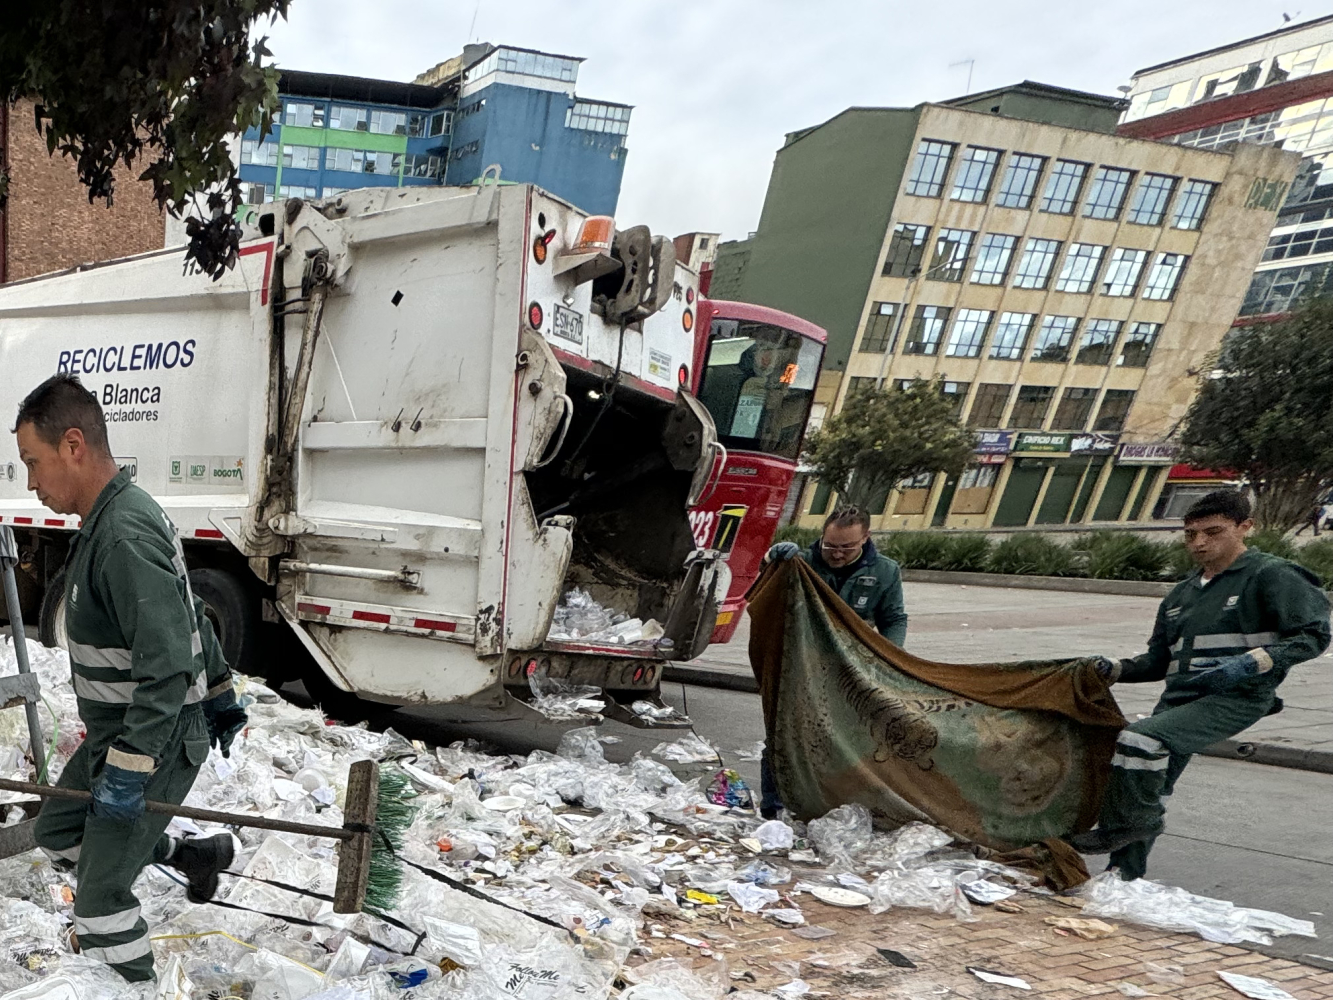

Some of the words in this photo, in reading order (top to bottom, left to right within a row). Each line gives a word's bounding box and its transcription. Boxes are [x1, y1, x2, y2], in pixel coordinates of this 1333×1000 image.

[1244, 177, 1287, 211] REX
[554, 305, 583, 337] ESN-670
[57, 339, 197, 374] RECICLEMOS
[102, 383, 162, 405] Blanca
[103, 408, 159, 423] cicladores
